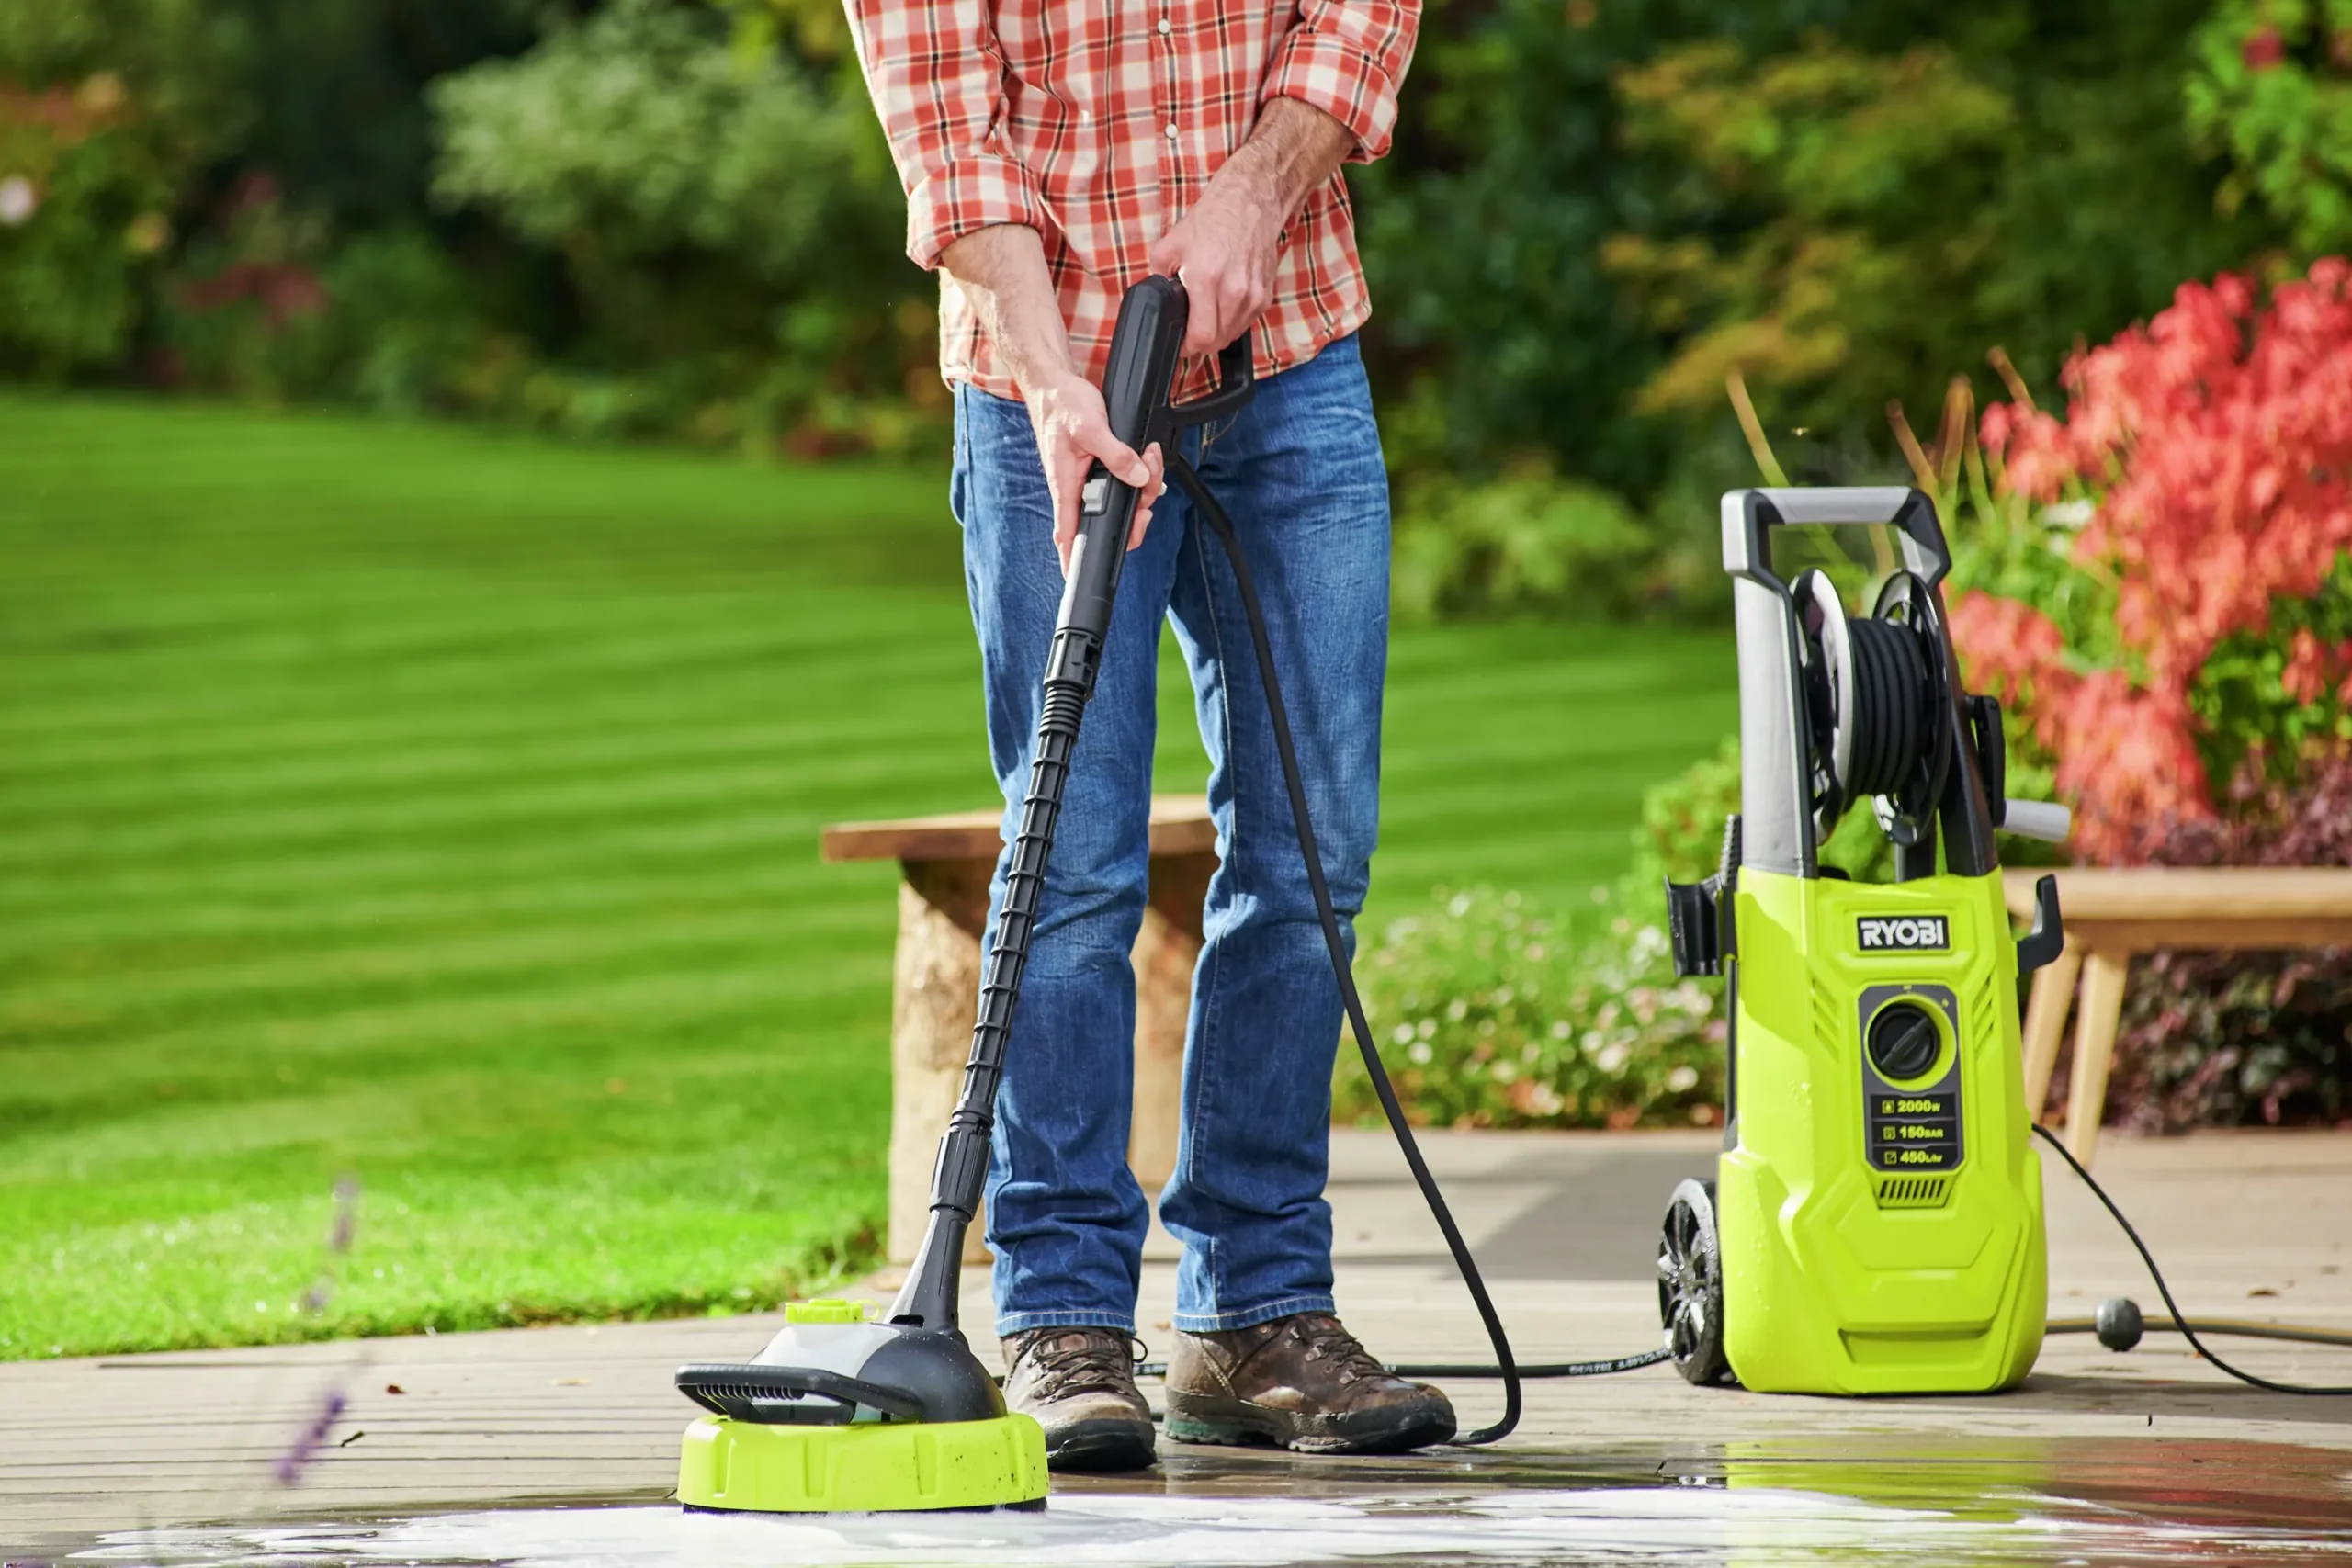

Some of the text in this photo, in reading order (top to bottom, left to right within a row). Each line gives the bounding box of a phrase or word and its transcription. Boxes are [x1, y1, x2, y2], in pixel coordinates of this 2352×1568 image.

[1860, 919, 1944, 946] RYOBI
[1897, 1100, 1941, 1113] 2000W
[1899, 1125, 1944, 1139] 150BAR
